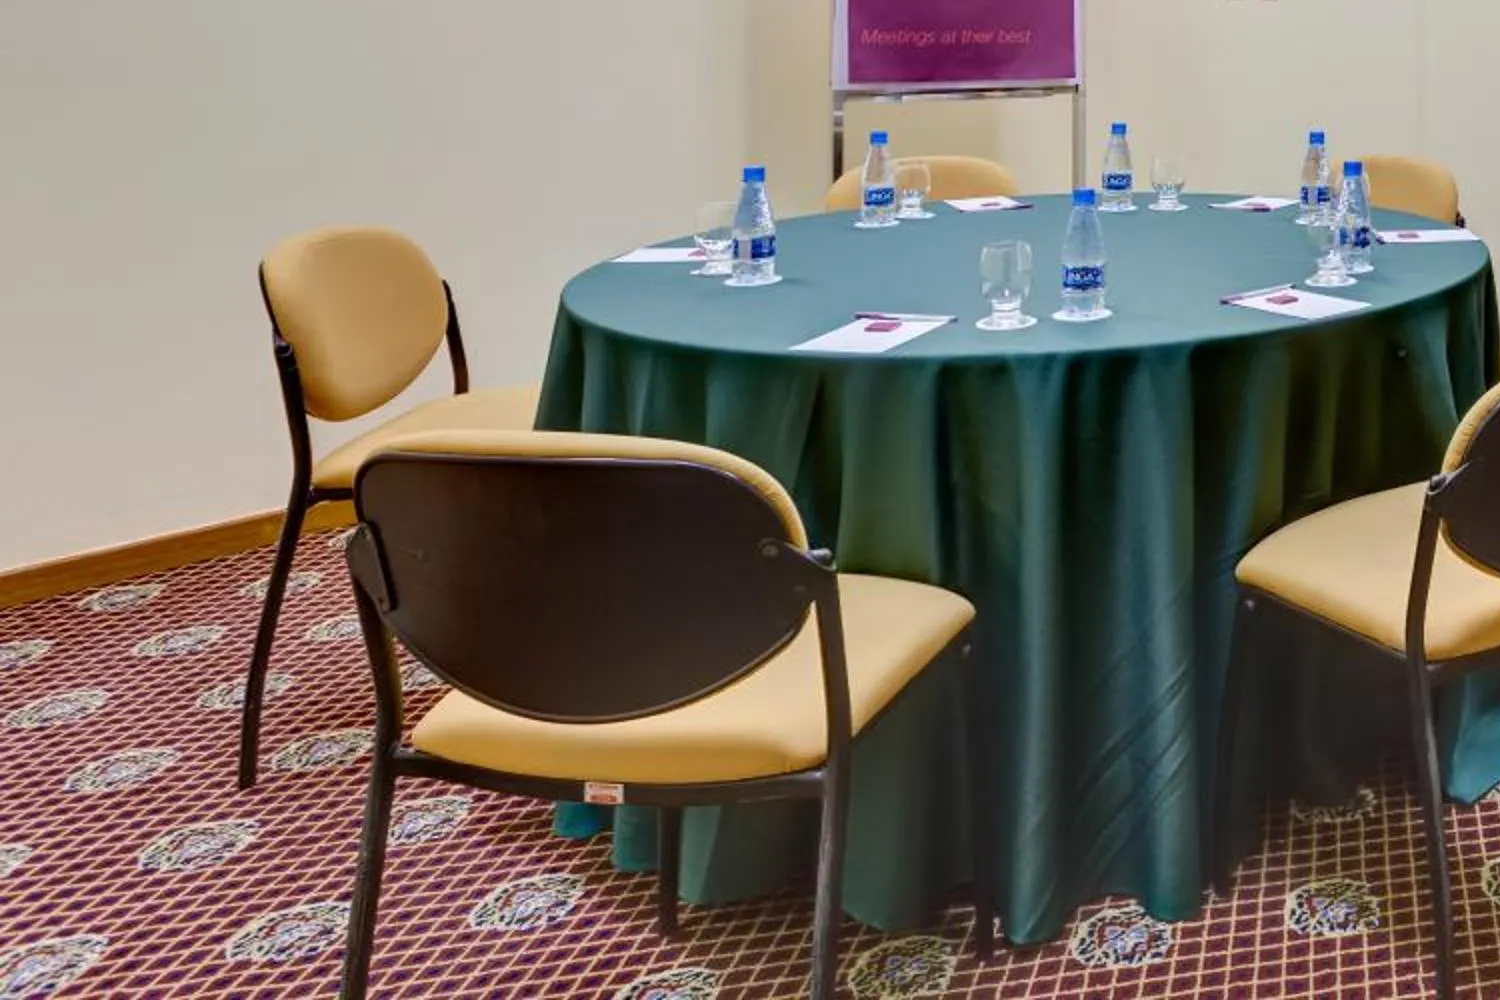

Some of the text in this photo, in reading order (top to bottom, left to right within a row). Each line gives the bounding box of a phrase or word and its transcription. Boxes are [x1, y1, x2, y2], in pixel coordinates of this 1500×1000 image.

[860, 28, 936, 48] Meetings
[940, 29, 957, 46] at
[997, 28, 1031, 45] best
